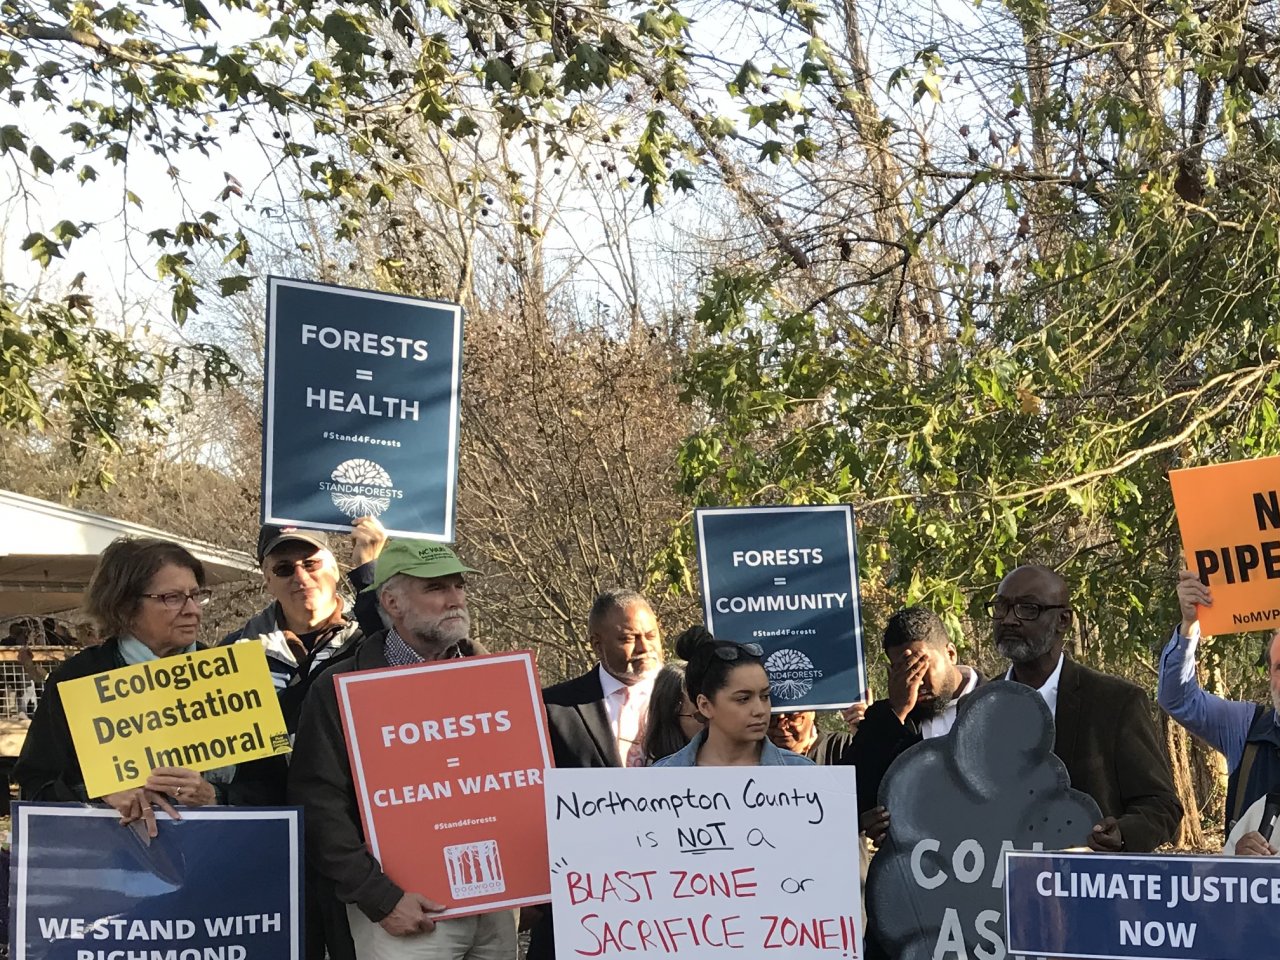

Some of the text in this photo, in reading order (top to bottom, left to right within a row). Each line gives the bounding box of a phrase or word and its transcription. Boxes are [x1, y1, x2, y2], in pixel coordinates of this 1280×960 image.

[301, 323, 429, 361] FORESTS
[355, 368, 373, 381] =
[306, 387, 420, 421] HEALTH
[323, 431, 401, 447] #Stand4Forests
[319, 481, 403, 499] STAND4FORESTS
[732, 548, 823, 567] FORESTS
[773, 577, 786, 585] =
[715, 593, 848, 614] COMMUNITY
[752, 628, 816, 637] #Stand4Forests
[93, 647, 239, 704] Ecological
[769, 670, 823, 680] ND4FORESTS
[92, 688, 262, 745] Devastation
[381, 710, 511, 748] FORESTS
[112, 723, 265, 783] is Immoral
[446, 757, 460, 768] =
[373, 768, 544, 808] CLEAN WATER
[556, 778, 825, 825] Northampton County
[433, 816, 497, 831] #Stand4Forests
[636, 822, 776, 849] is NOT a
[455, 881, 501, 893] DOGWOOD
[566, 867, 815, 906] BLAST ZONE or
[1035, 871, 1162, 901] CLIMATE
[38, 912, 282, 941] WE STAND WITH
[574, 913, 859, 960] SACRIFICE ZONE!!
[1119, 919, 1197, 949] NOW
